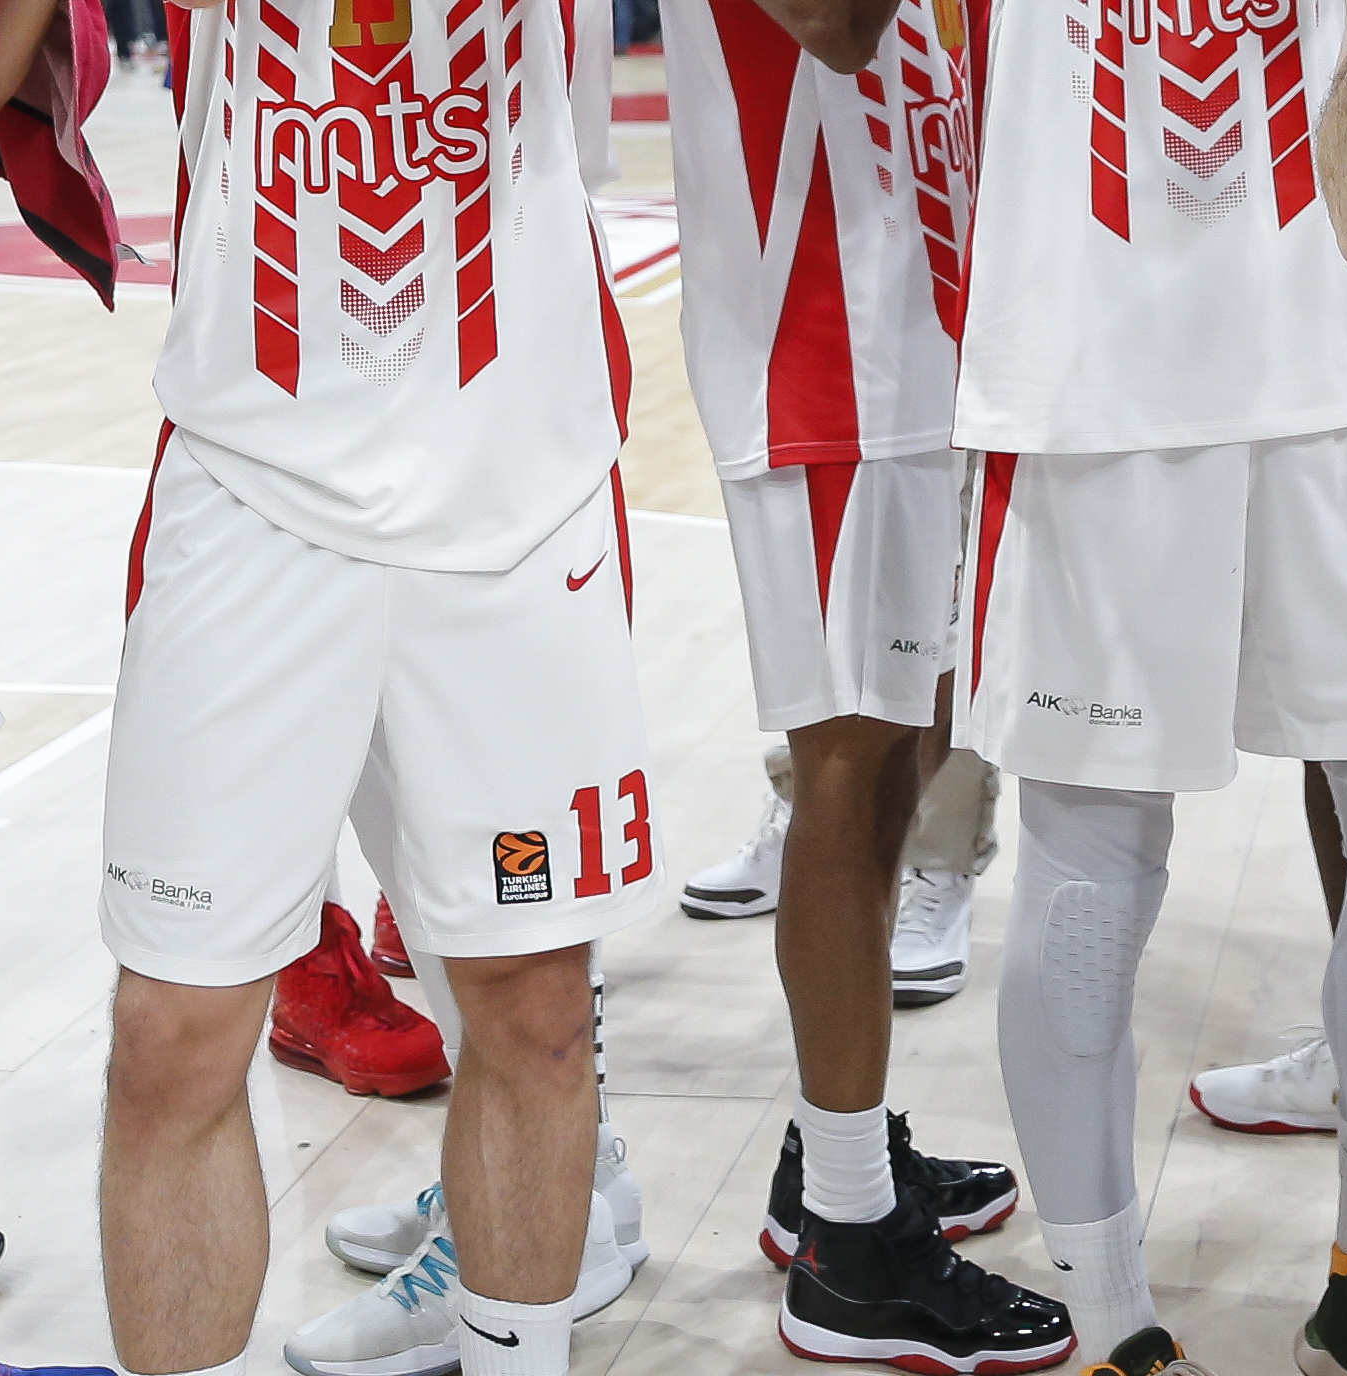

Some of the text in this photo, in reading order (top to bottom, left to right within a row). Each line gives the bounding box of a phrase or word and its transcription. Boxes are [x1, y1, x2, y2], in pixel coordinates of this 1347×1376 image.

[260, 80, 489, 197] mts
[890, 638, 920, 654] AIK
[1027, 691, 1142, 721] AIK Banka
[569, 768, 654, 899] 13
[108, 862, 213, 904] AIK Banka
[501, 873, 547, 885] TURKISH
[502, 882, 547, 893] AIRLINES
